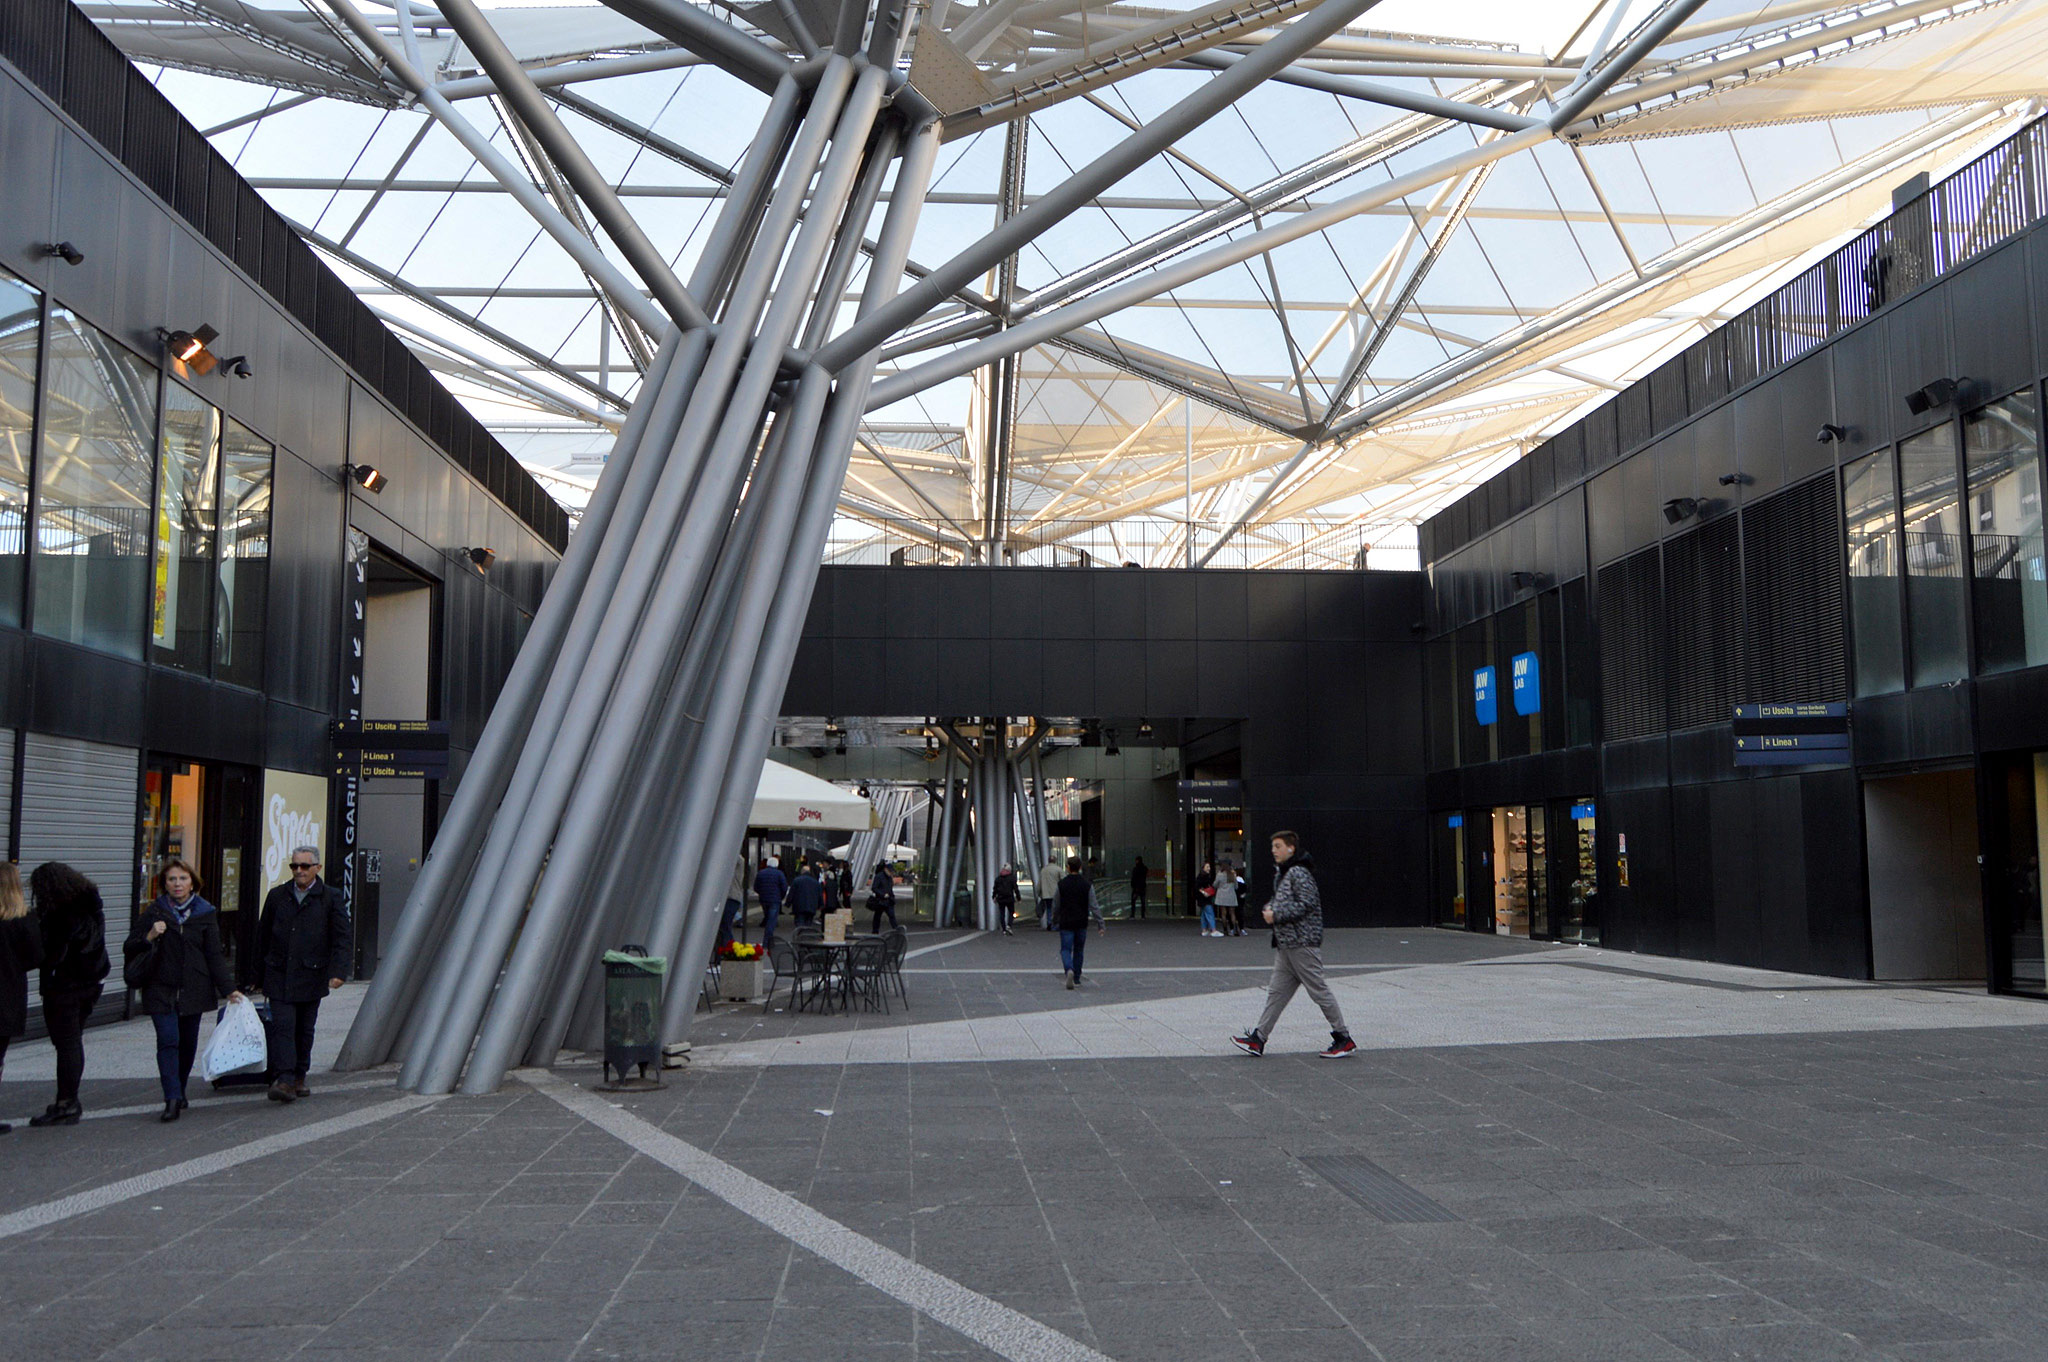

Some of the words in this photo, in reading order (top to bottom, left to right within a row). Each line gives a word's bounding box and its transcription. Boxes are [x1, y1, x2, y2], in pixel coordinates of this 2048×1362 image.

[1514, 658, 1528, 677] AW
[1476, 672, 1488, 689] AW
[1514, 678, 1524, 690] LAB
[1475, 690, 1485, 701] LAB
[1772, 706, 1794, 715] Uscita
[1772, 738, 1792, 746] Linea
[1793, 738, 1798, 746] 1
[373, 768, 395, 776] Uscita
